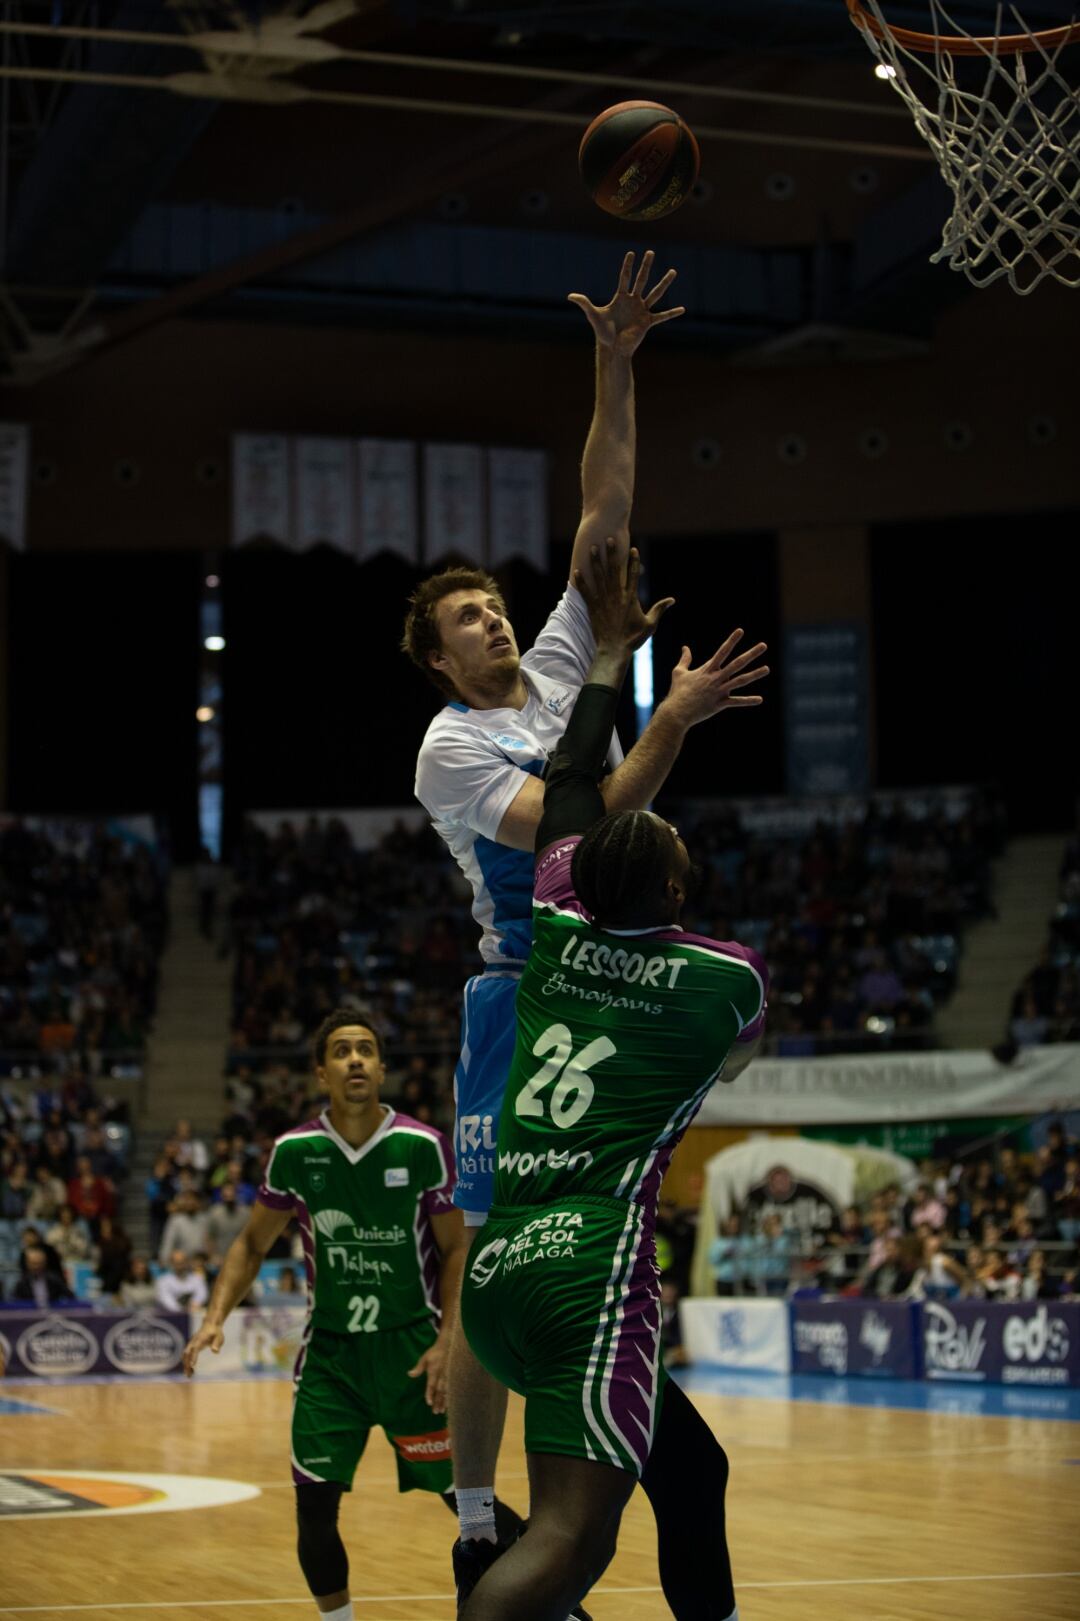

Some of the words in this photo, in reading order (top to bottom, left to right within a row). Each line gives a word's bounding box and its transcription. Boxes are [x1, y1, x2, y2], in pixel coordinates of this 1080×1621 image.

[560, 933, 688, 990] LESSORT
[515, 1022, 617, 1129] 26
[460, 1114, 498, 1154] Ri
[352, 1224, 408, 1243] Unicaja
[505, 1234, 535, 1259] DEL
[538, 1229, 579, 1245] SOL
[347, 1294, 381, 1334] 22
